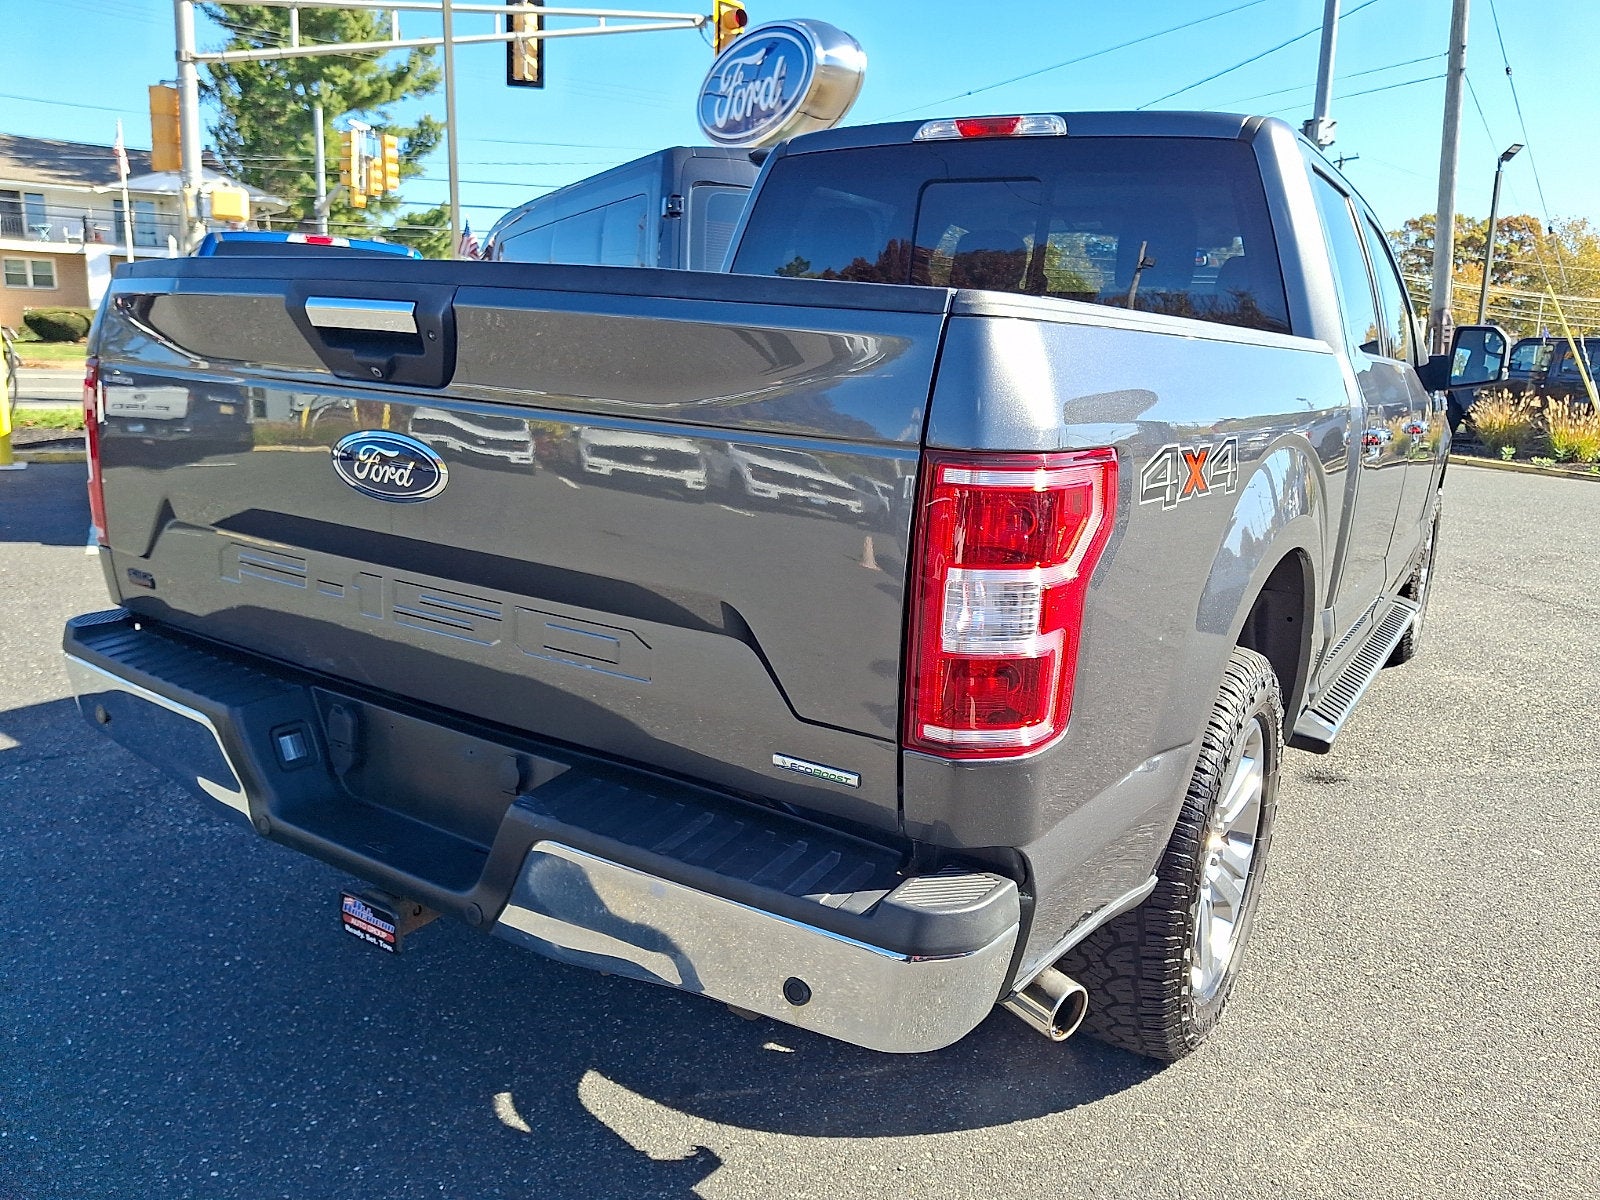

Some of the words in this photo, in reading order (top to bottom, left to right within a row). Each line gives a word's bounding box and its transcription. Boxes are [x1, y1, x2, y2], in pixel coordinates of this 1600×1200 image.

[714, 48, 785, 129] Ford
[354, 445, 415, 487] Ford
[218, 542, 652, 684] F-150
